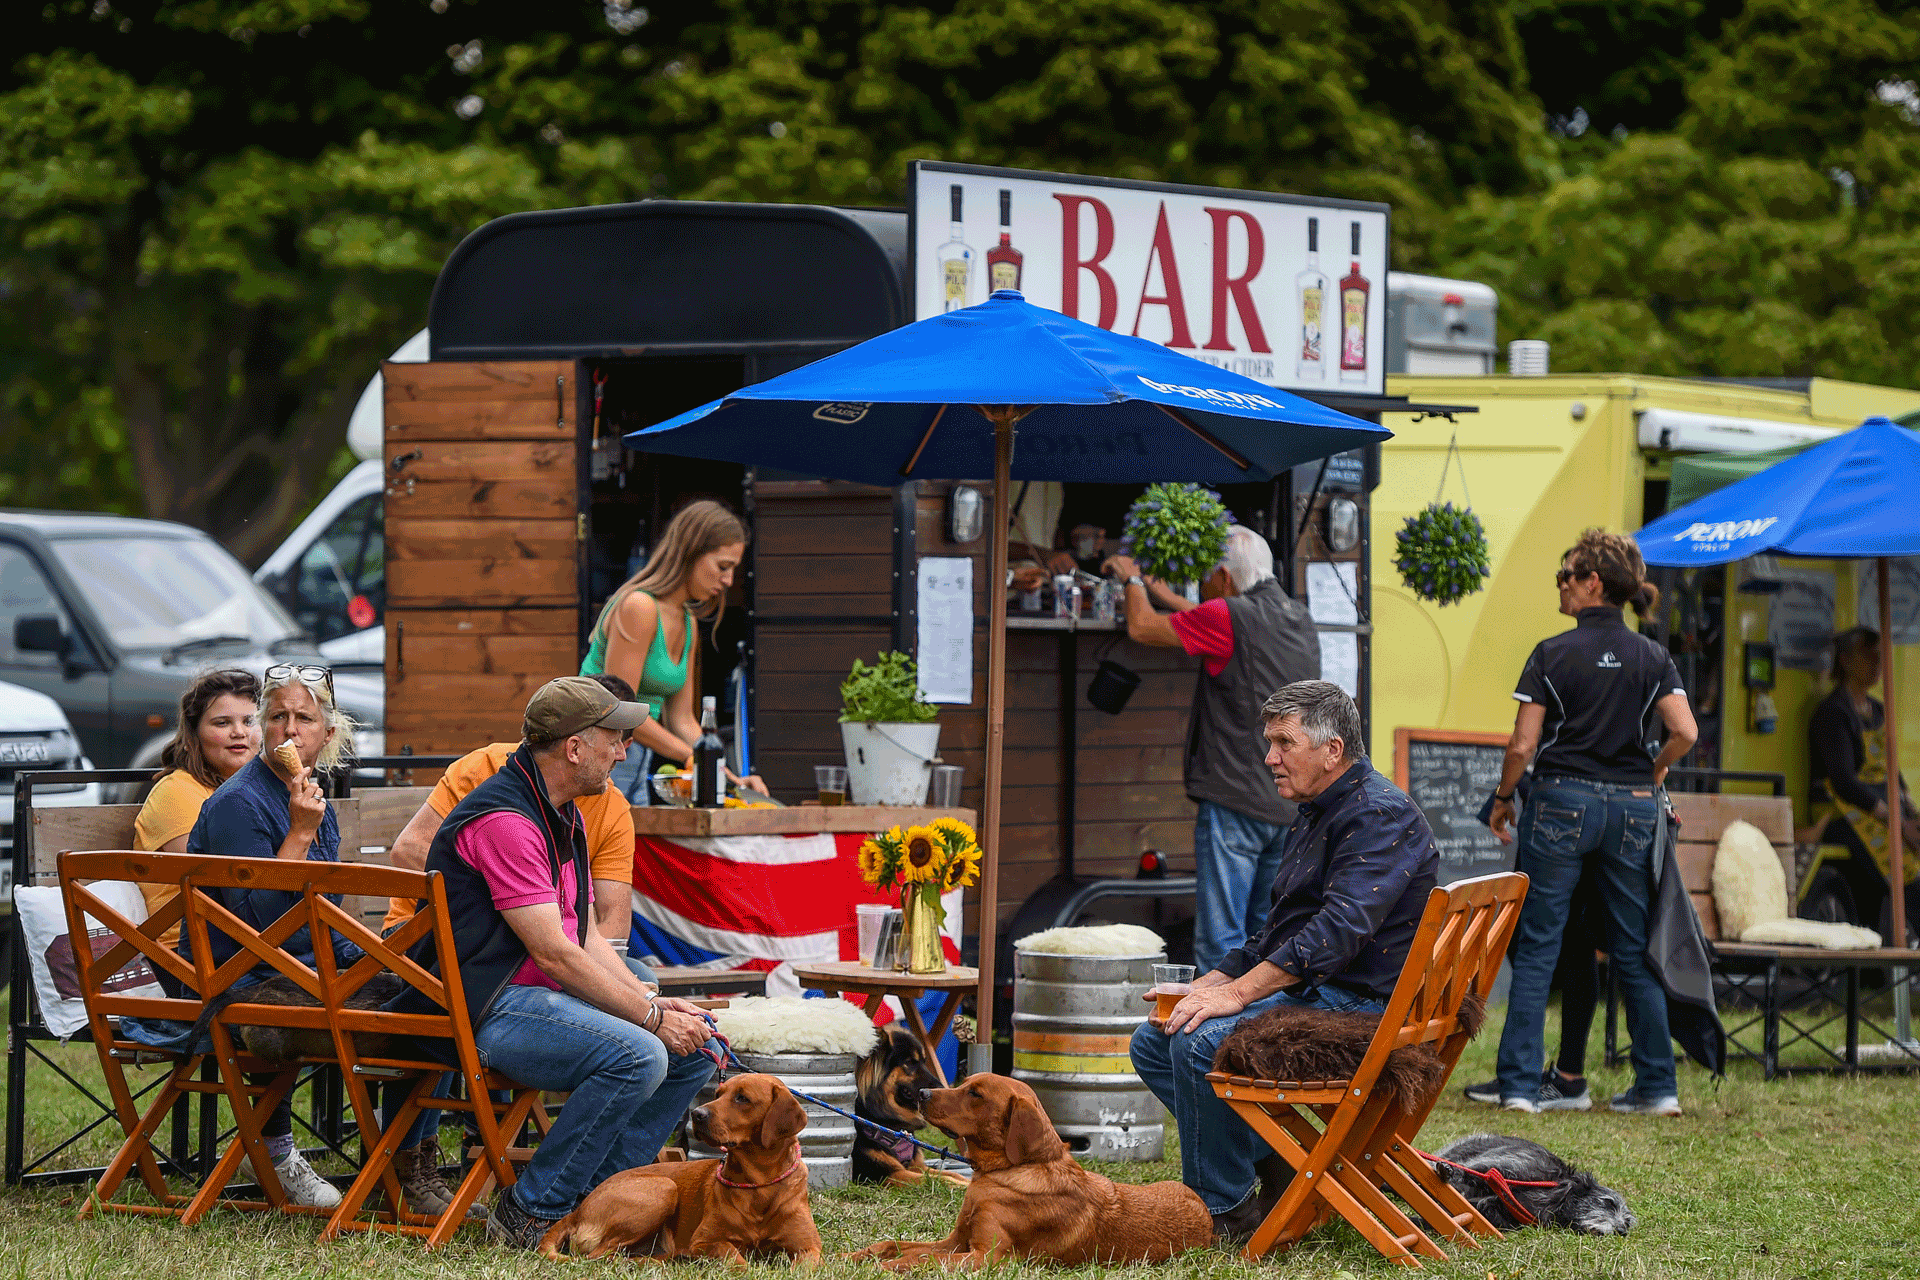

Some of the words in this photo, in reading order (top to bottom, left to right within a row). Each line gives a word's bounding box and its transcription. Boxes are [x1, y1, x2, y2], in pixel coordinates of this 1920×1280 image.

[1052, 192, 1273, 354] BAR
[1232, 357, 1274, 378] CIDER
[1673, 516, 1778, 542] PERONI
